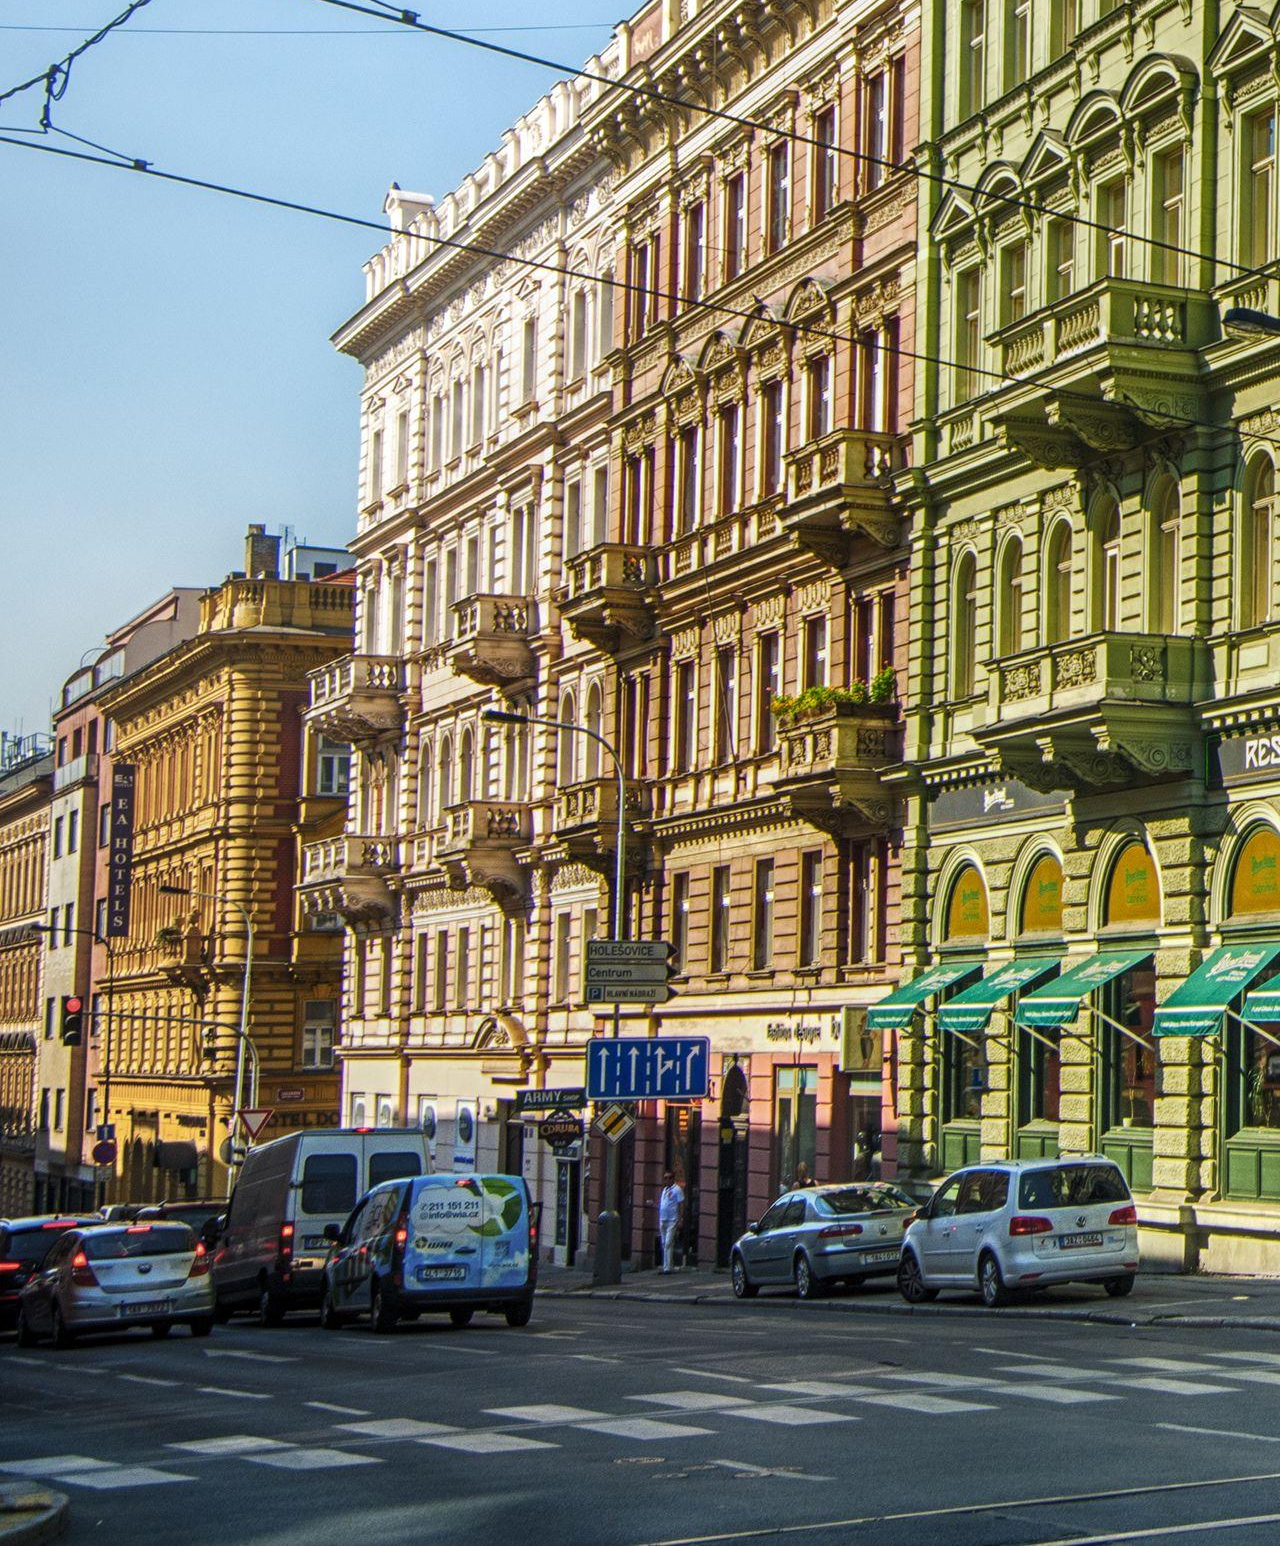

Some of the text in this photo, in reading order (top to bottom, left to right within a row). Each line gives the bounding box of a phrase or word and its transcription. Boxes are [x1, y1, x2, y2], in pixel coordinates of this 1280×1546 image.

[114, 838, 128, 927] HOTELS
[590, 943, 654, 956] HOLEŠOVICE
[589, 968, 632, 978] Centrum
[524, 1091, 562, 1104] ARMY
[267, 1112, 312, 1127] OTEL
[429, 1201, 479, 1211] 211 151 211
